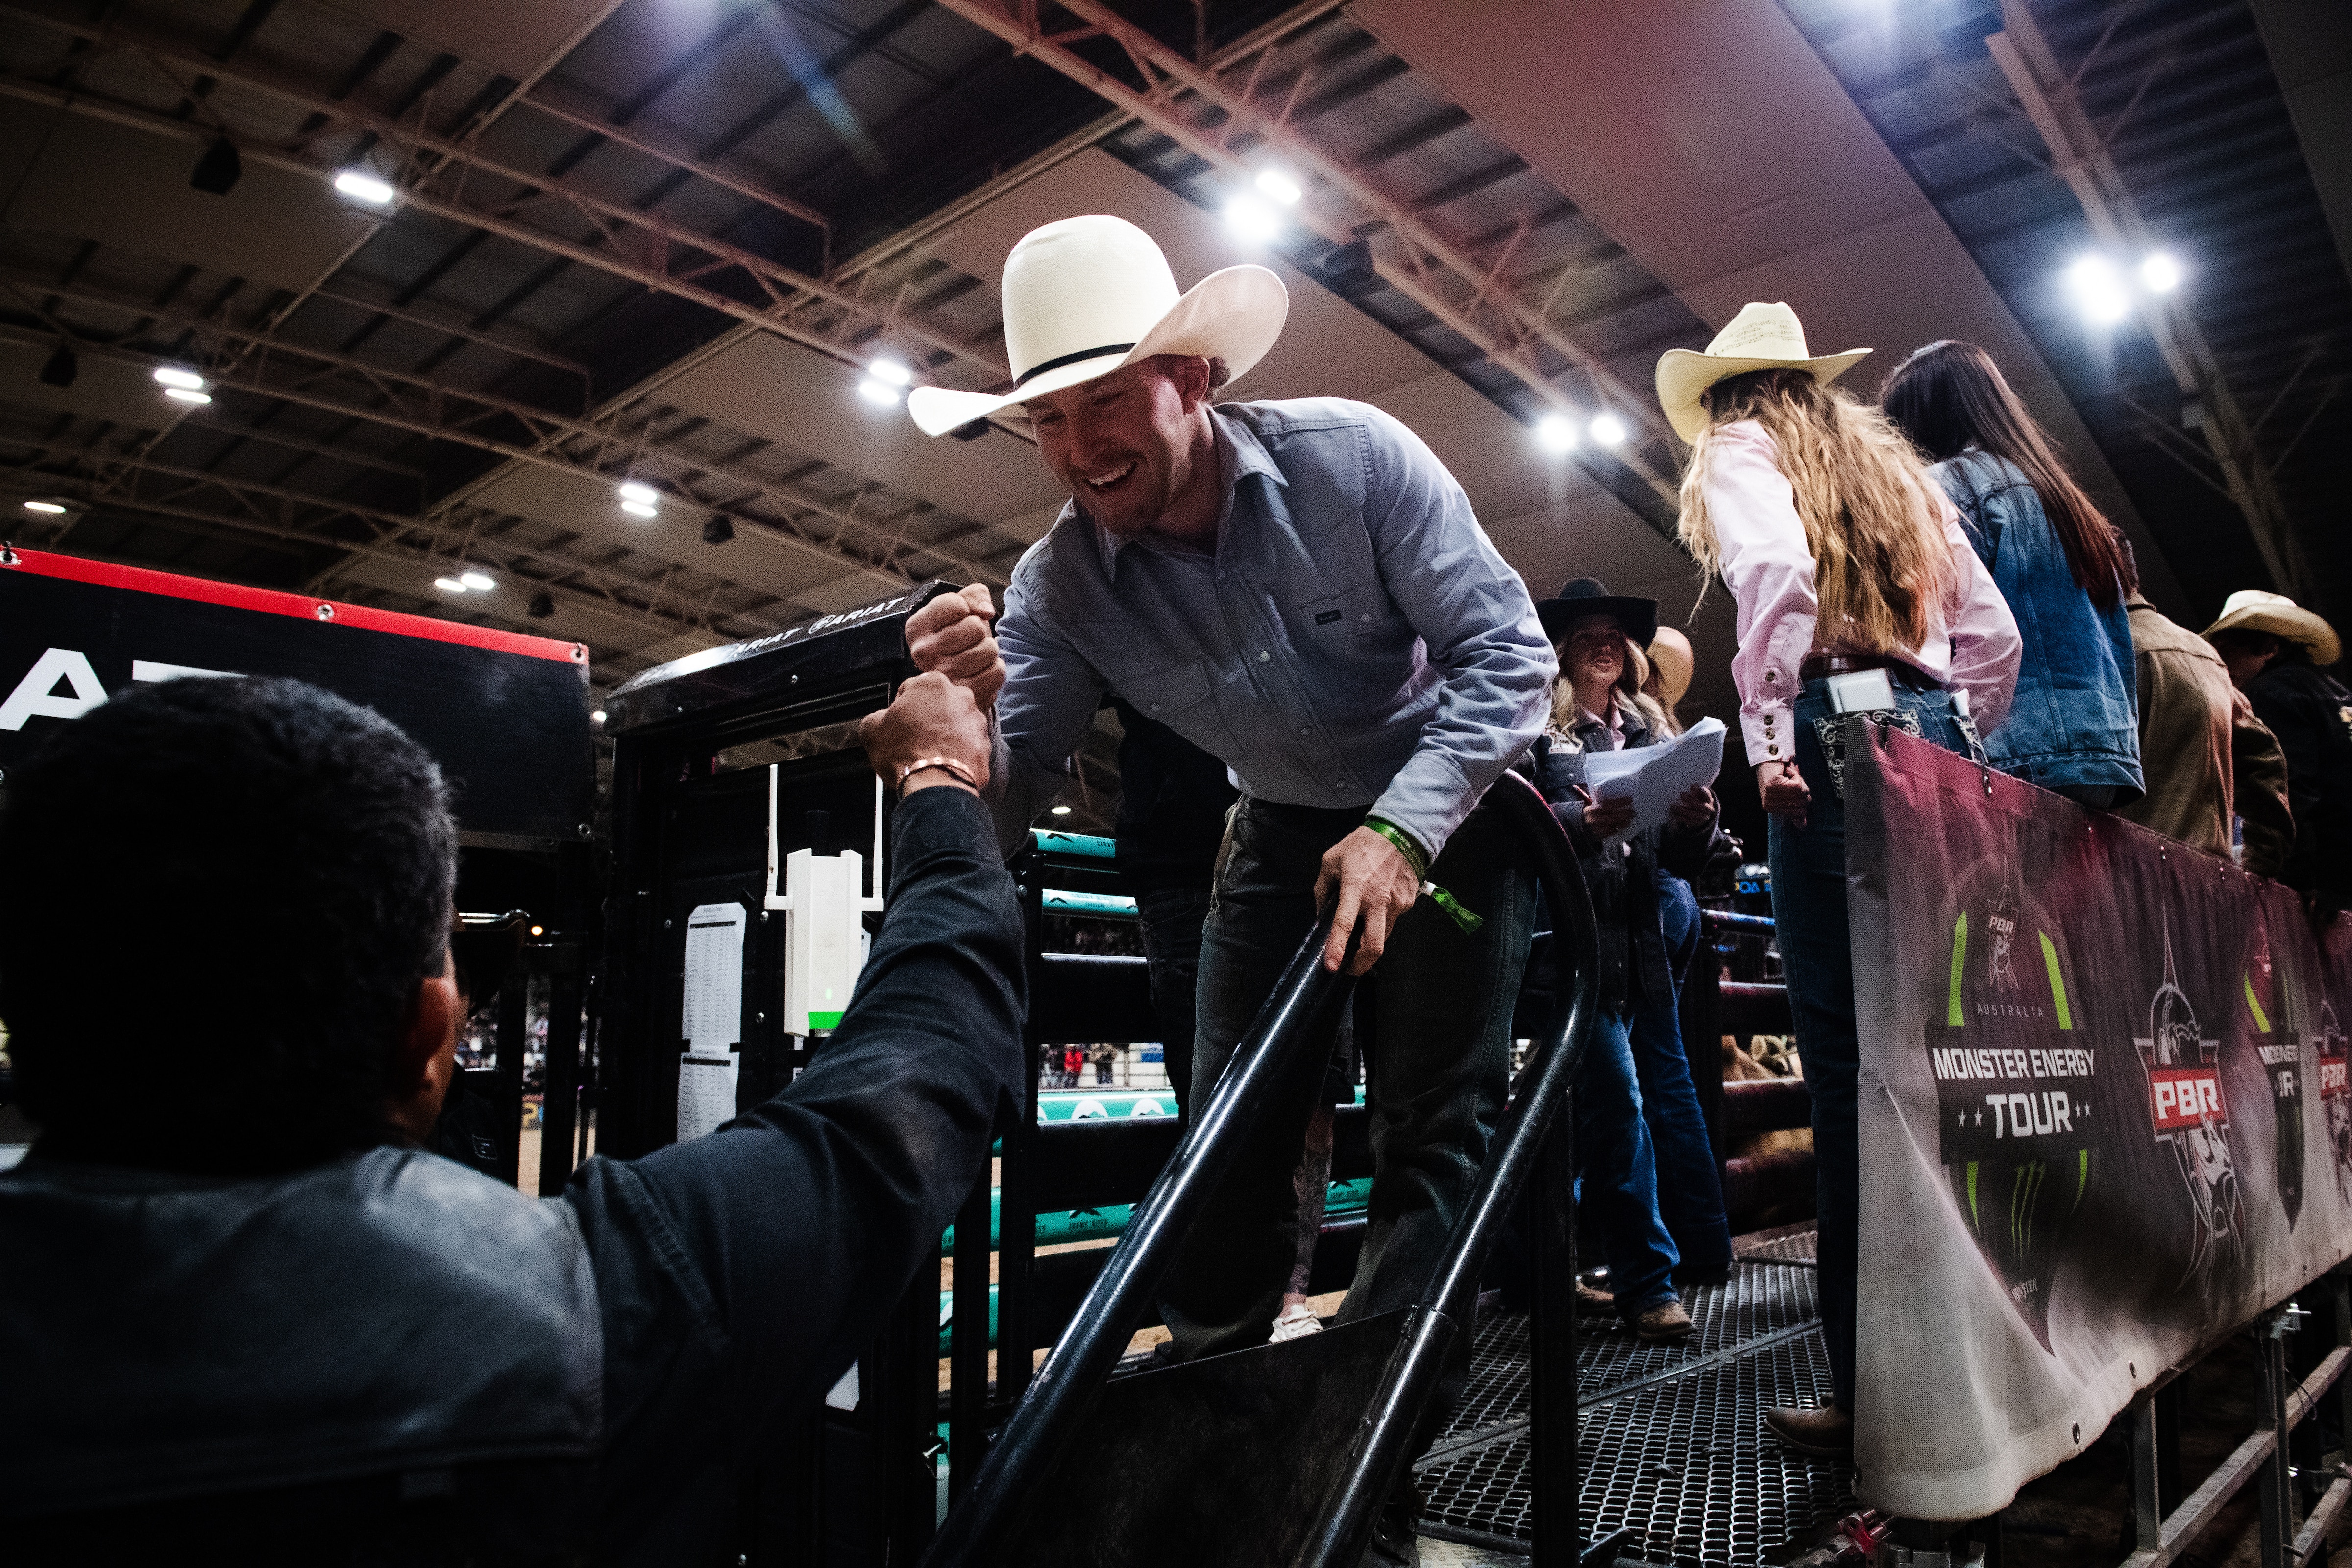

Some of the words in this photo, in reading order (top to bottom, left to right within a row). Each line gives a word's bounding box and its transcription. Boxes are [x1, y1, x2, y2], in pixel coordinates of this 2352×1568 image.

[824, 597, 905, 628] ARIAT
[1989, 915, 2014, 933] PBR
[1977, 1003, 2044, 1018] AUSTRALIA
[1933, 1047, 2030, 1079] MONSTER
[2032, 1048, 2095, 1078] ENERGY
[2153, 1078, 2219, 1120] PBR
[1985, 1091, 2073, 1139] TOUR
